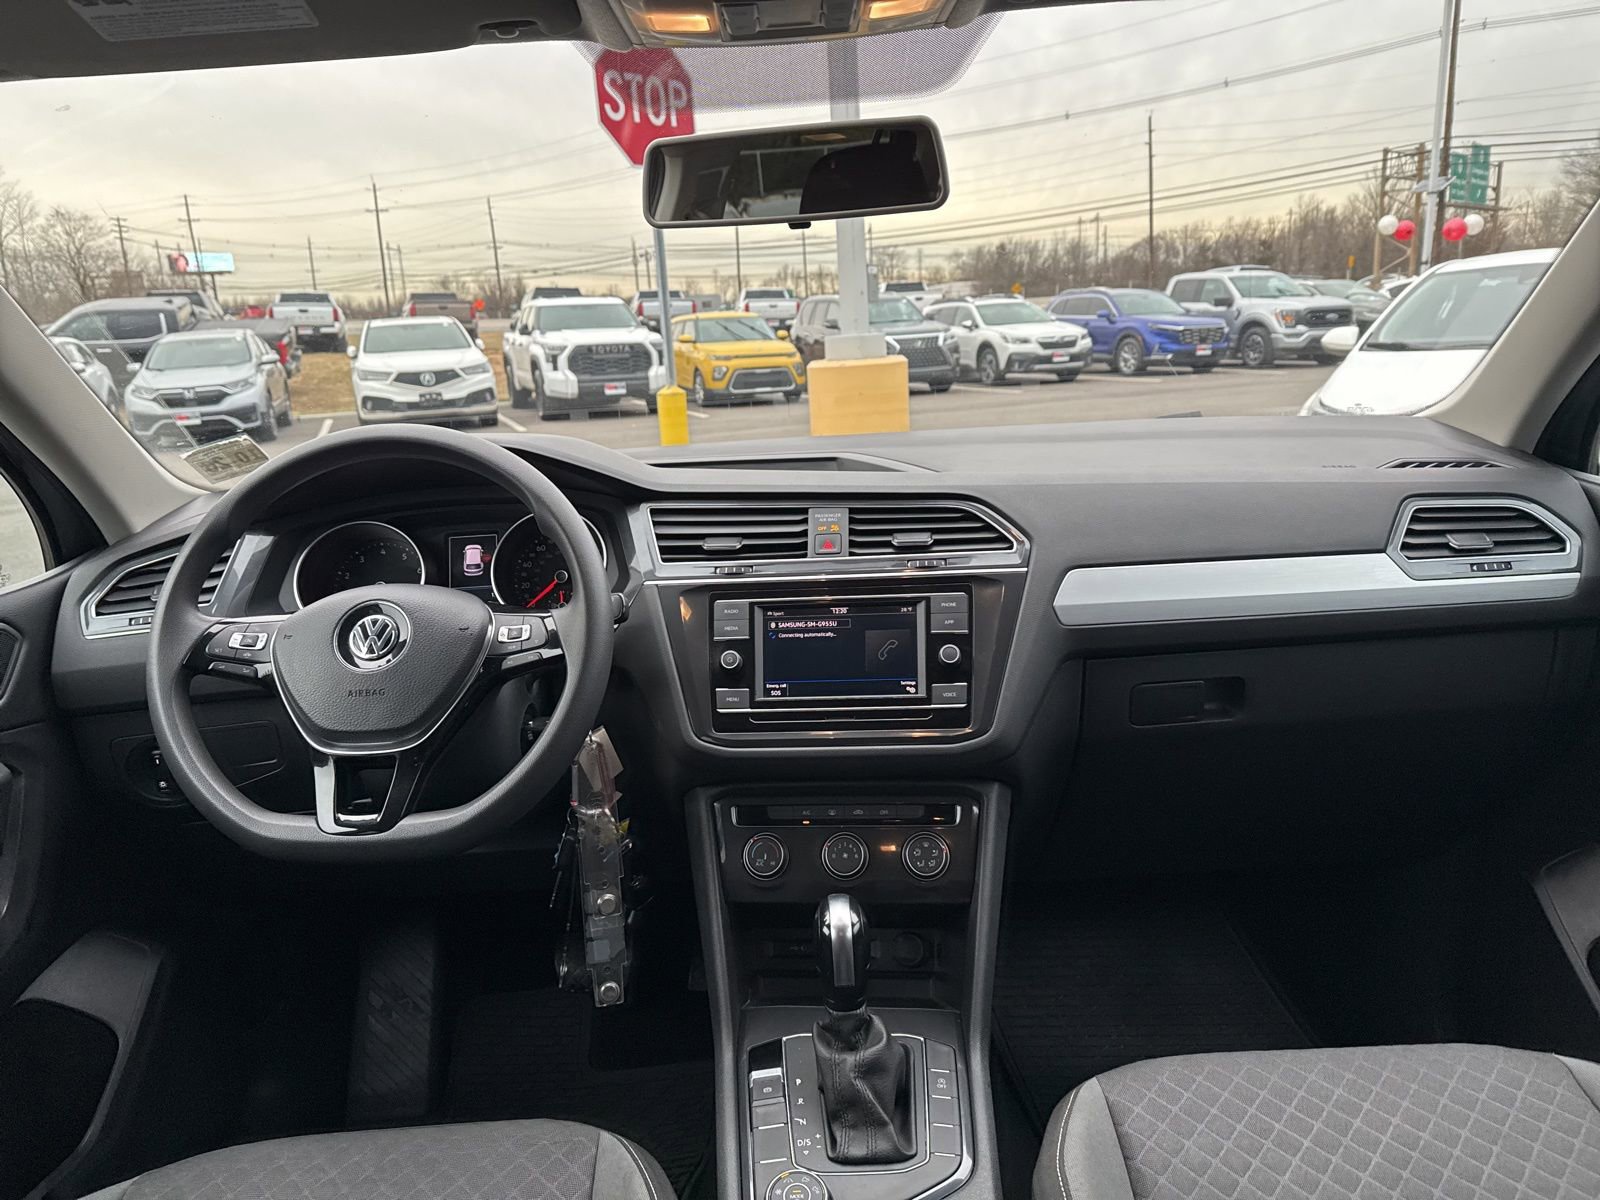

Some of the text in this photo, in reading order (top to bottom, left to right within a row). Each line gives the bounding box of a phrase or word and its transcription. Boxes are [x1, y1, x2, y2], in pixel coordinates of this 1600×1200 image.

[602, 69, 688, 128] STOP
[591, 344, 632, 355] TOYOTA
[536, 544, 546, 552] 60
[522, 560, 532, 568] 40
[778, 620, 838, 628] SAMSUNG-SM-G955U
[347, 688, 386, 698] AIRBAG
[795, 1078, 802, 1086] P
[797, 1097, 805, 1105] R
[797, 1138, 812, 1147] D/S
